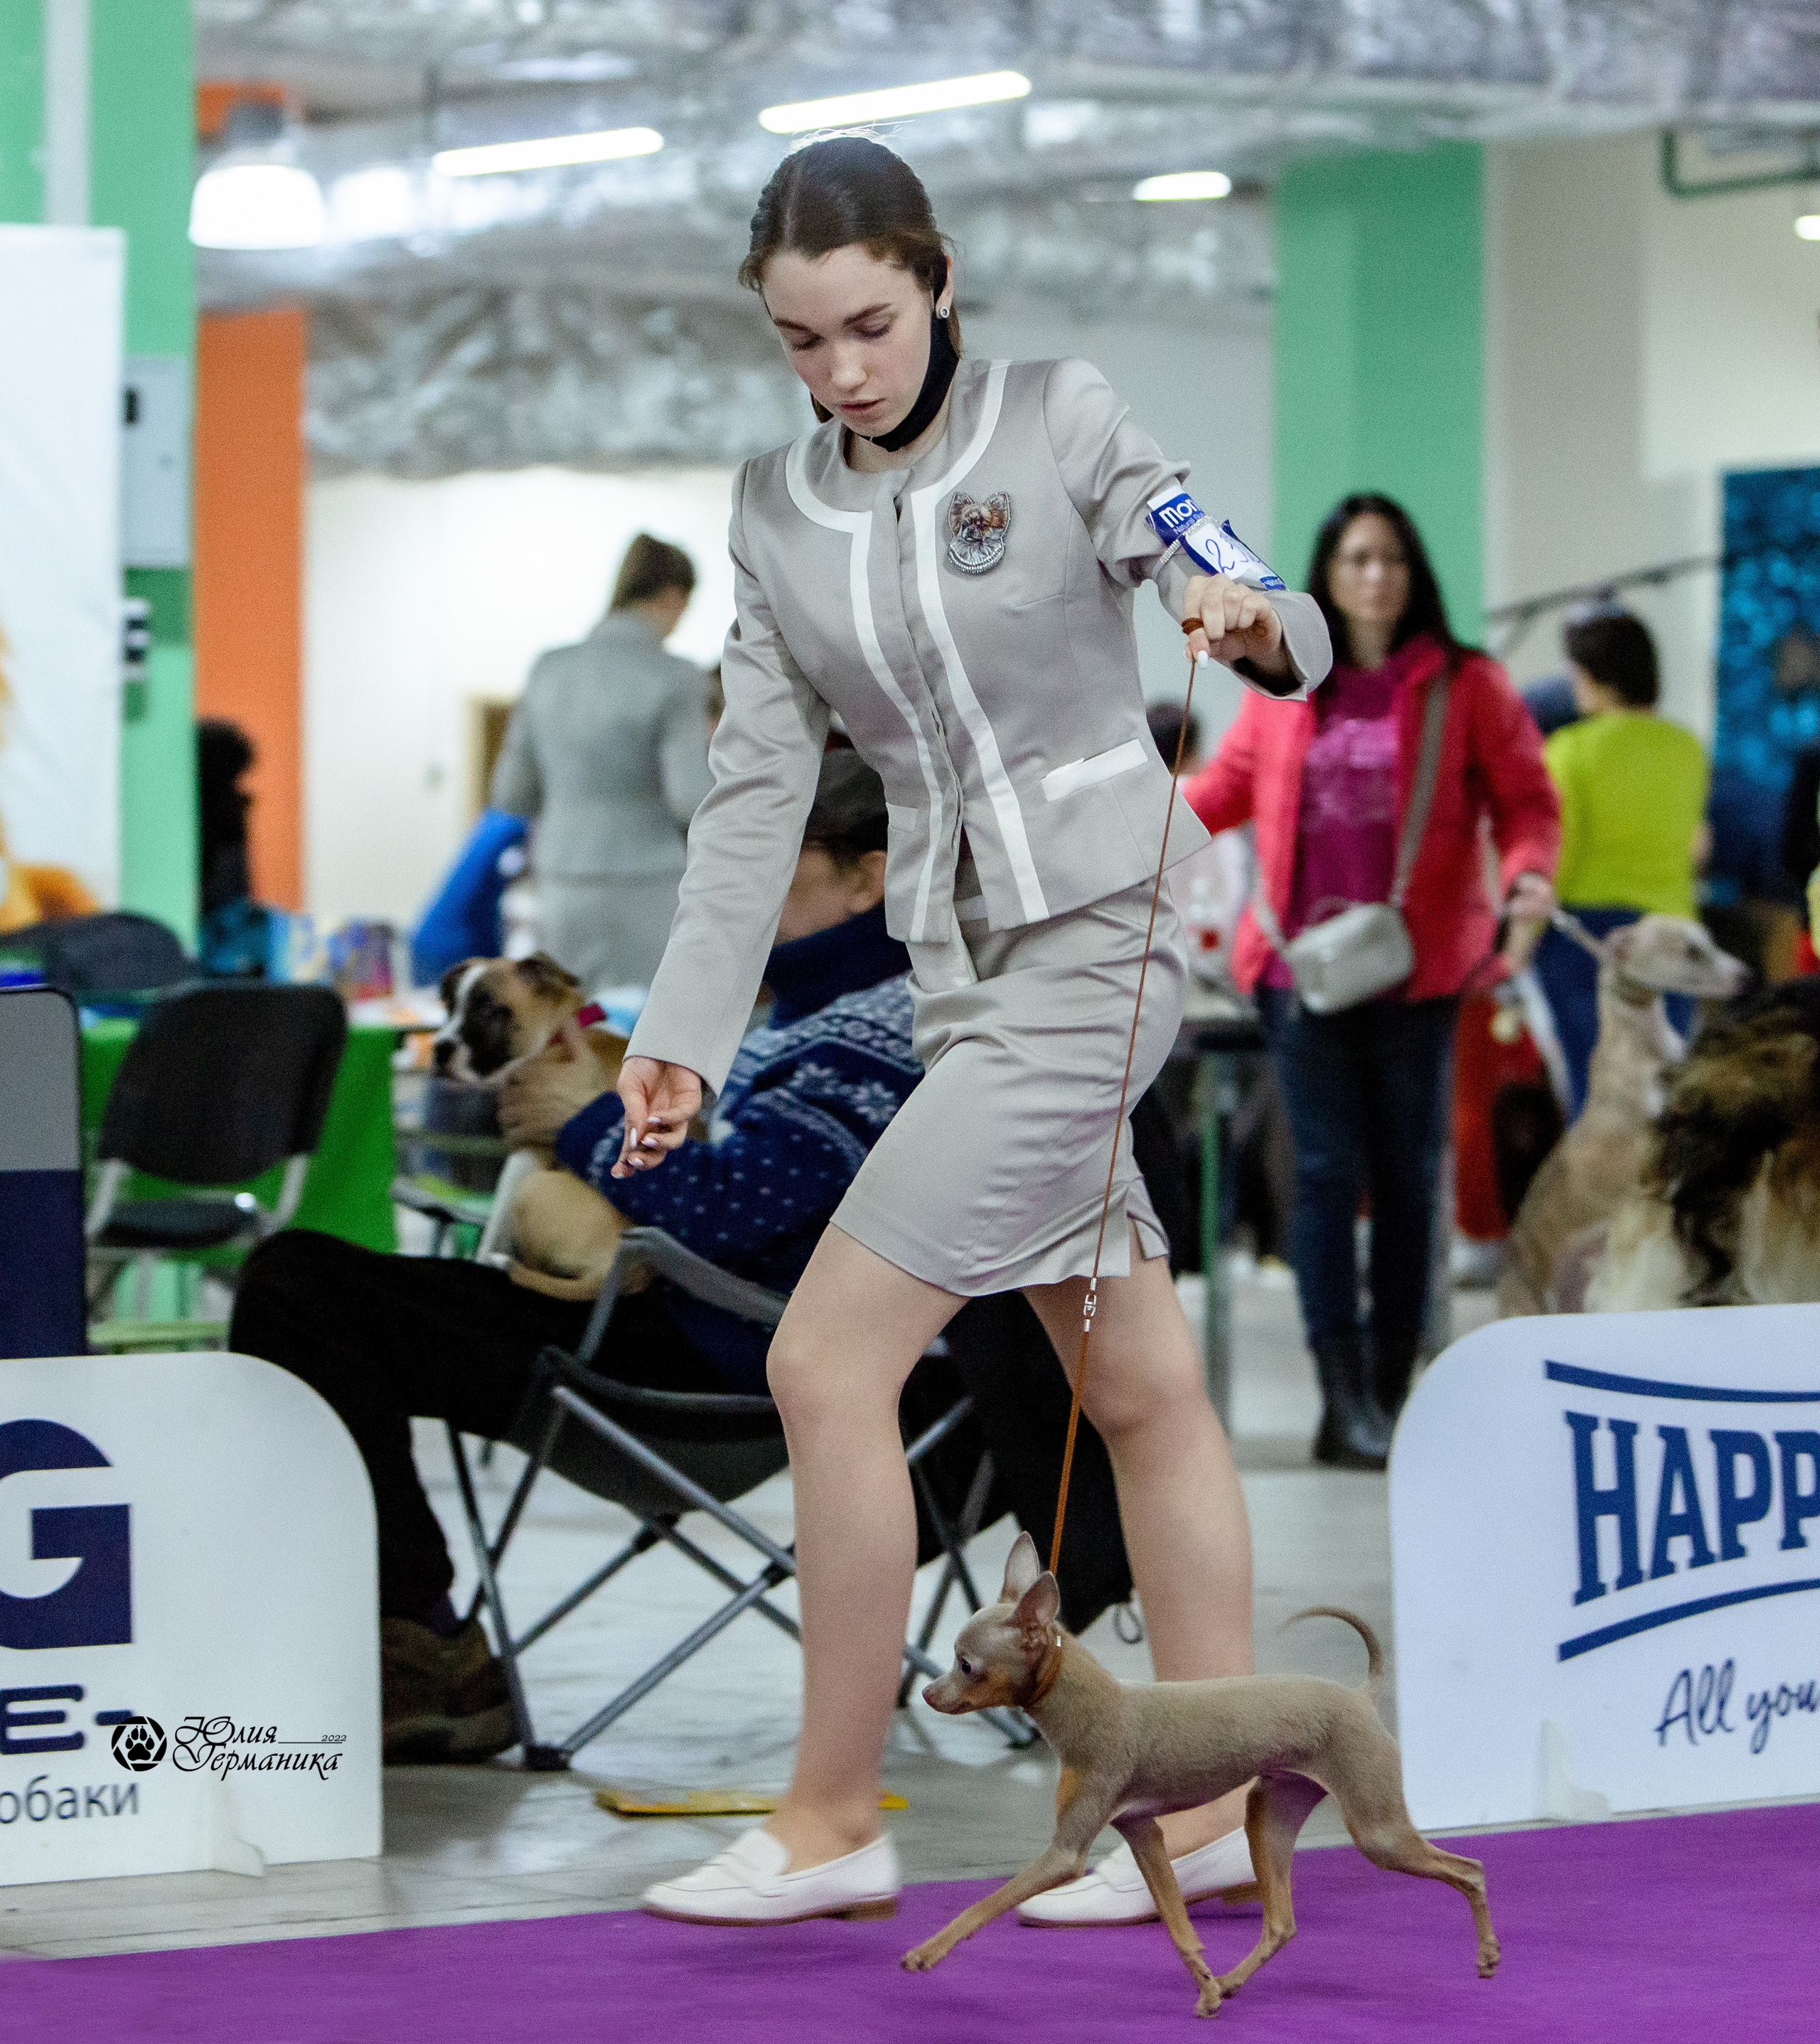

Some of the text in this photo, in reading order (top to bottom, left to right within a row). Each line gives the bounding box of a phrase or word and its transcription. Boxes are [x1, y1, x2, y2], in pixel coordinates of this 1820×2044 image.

[1173, 517, 1195, 535] Natural
[1563, 1409, 1820, 1607] HAPP
[1654, 1657, 1735, 1747] All
